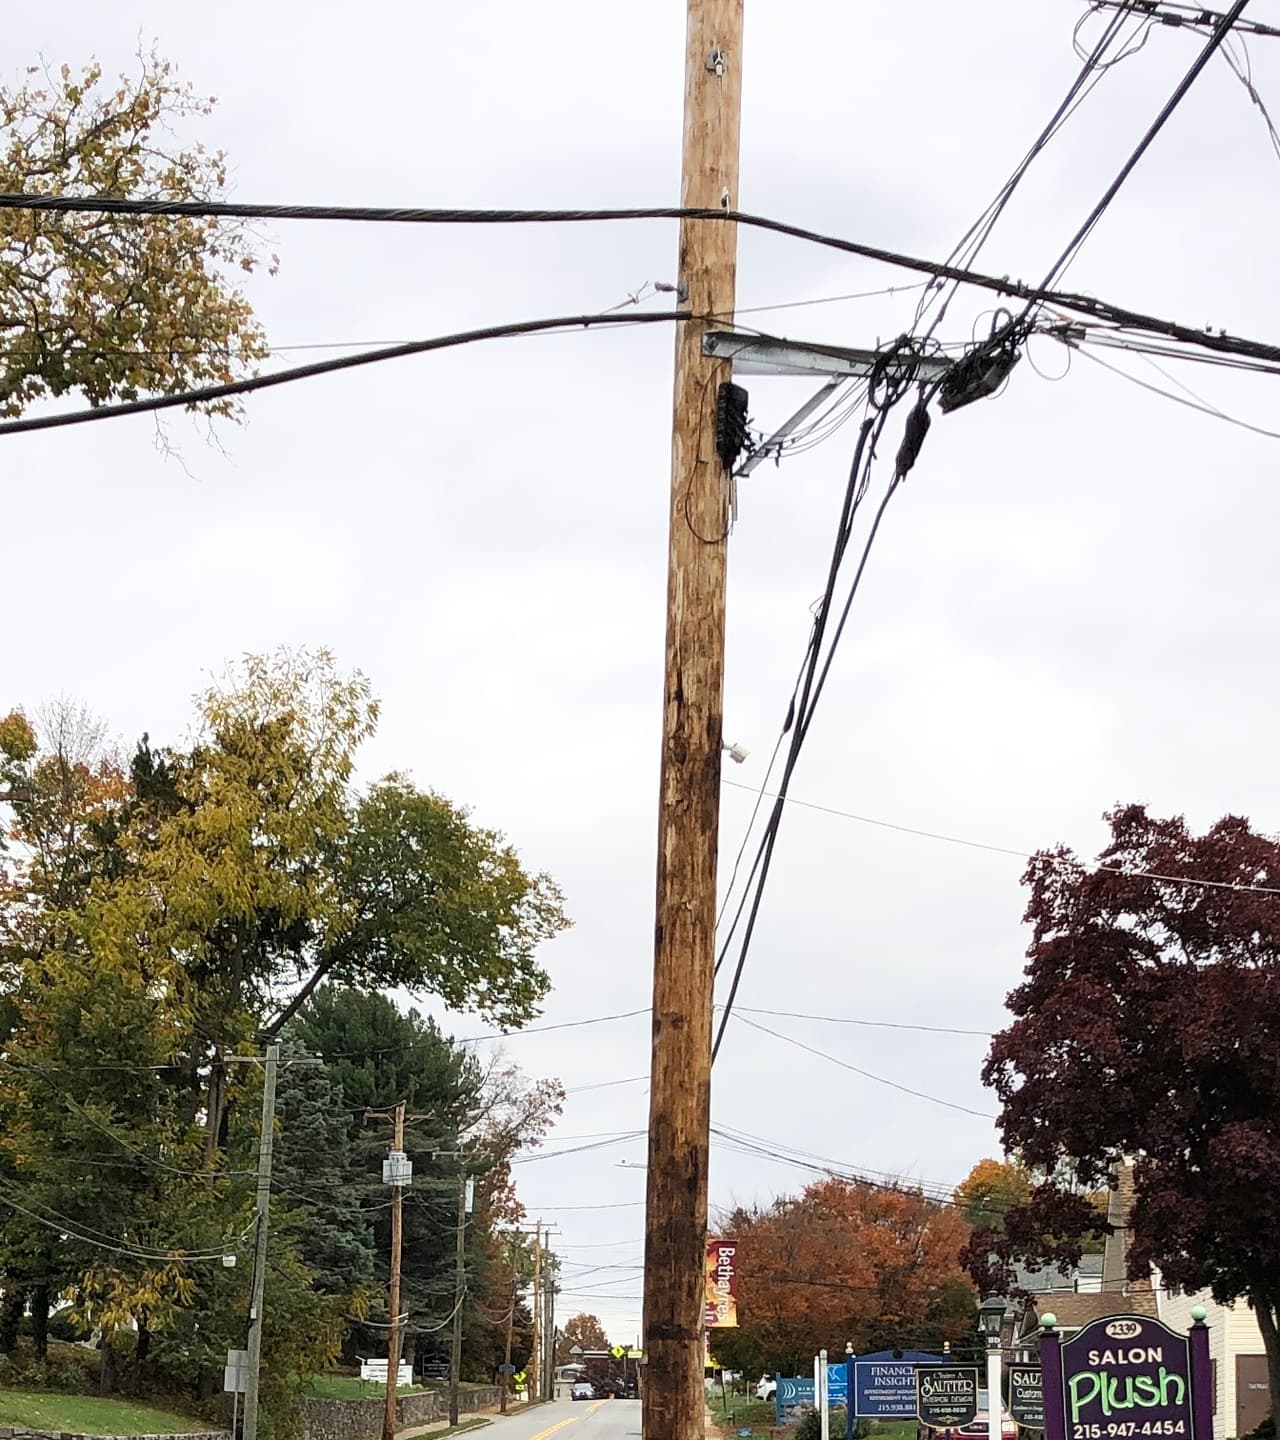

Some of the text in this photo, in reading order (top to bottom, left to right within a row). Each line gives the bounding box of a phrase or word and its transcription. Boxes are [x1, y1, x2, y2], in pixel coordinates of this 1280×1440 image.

[713, 1247, 736, 1321] Bethayres
[1110, 1323, 1137, 1335] 2339
[1088, 1347, 1163, 1366] SALON
[871, 1366, 916, 1376] FINANCI
[1068, 1366, 1186, 1424] Plush
[1073, 1420, 1185, 1440] 215-947-4454
